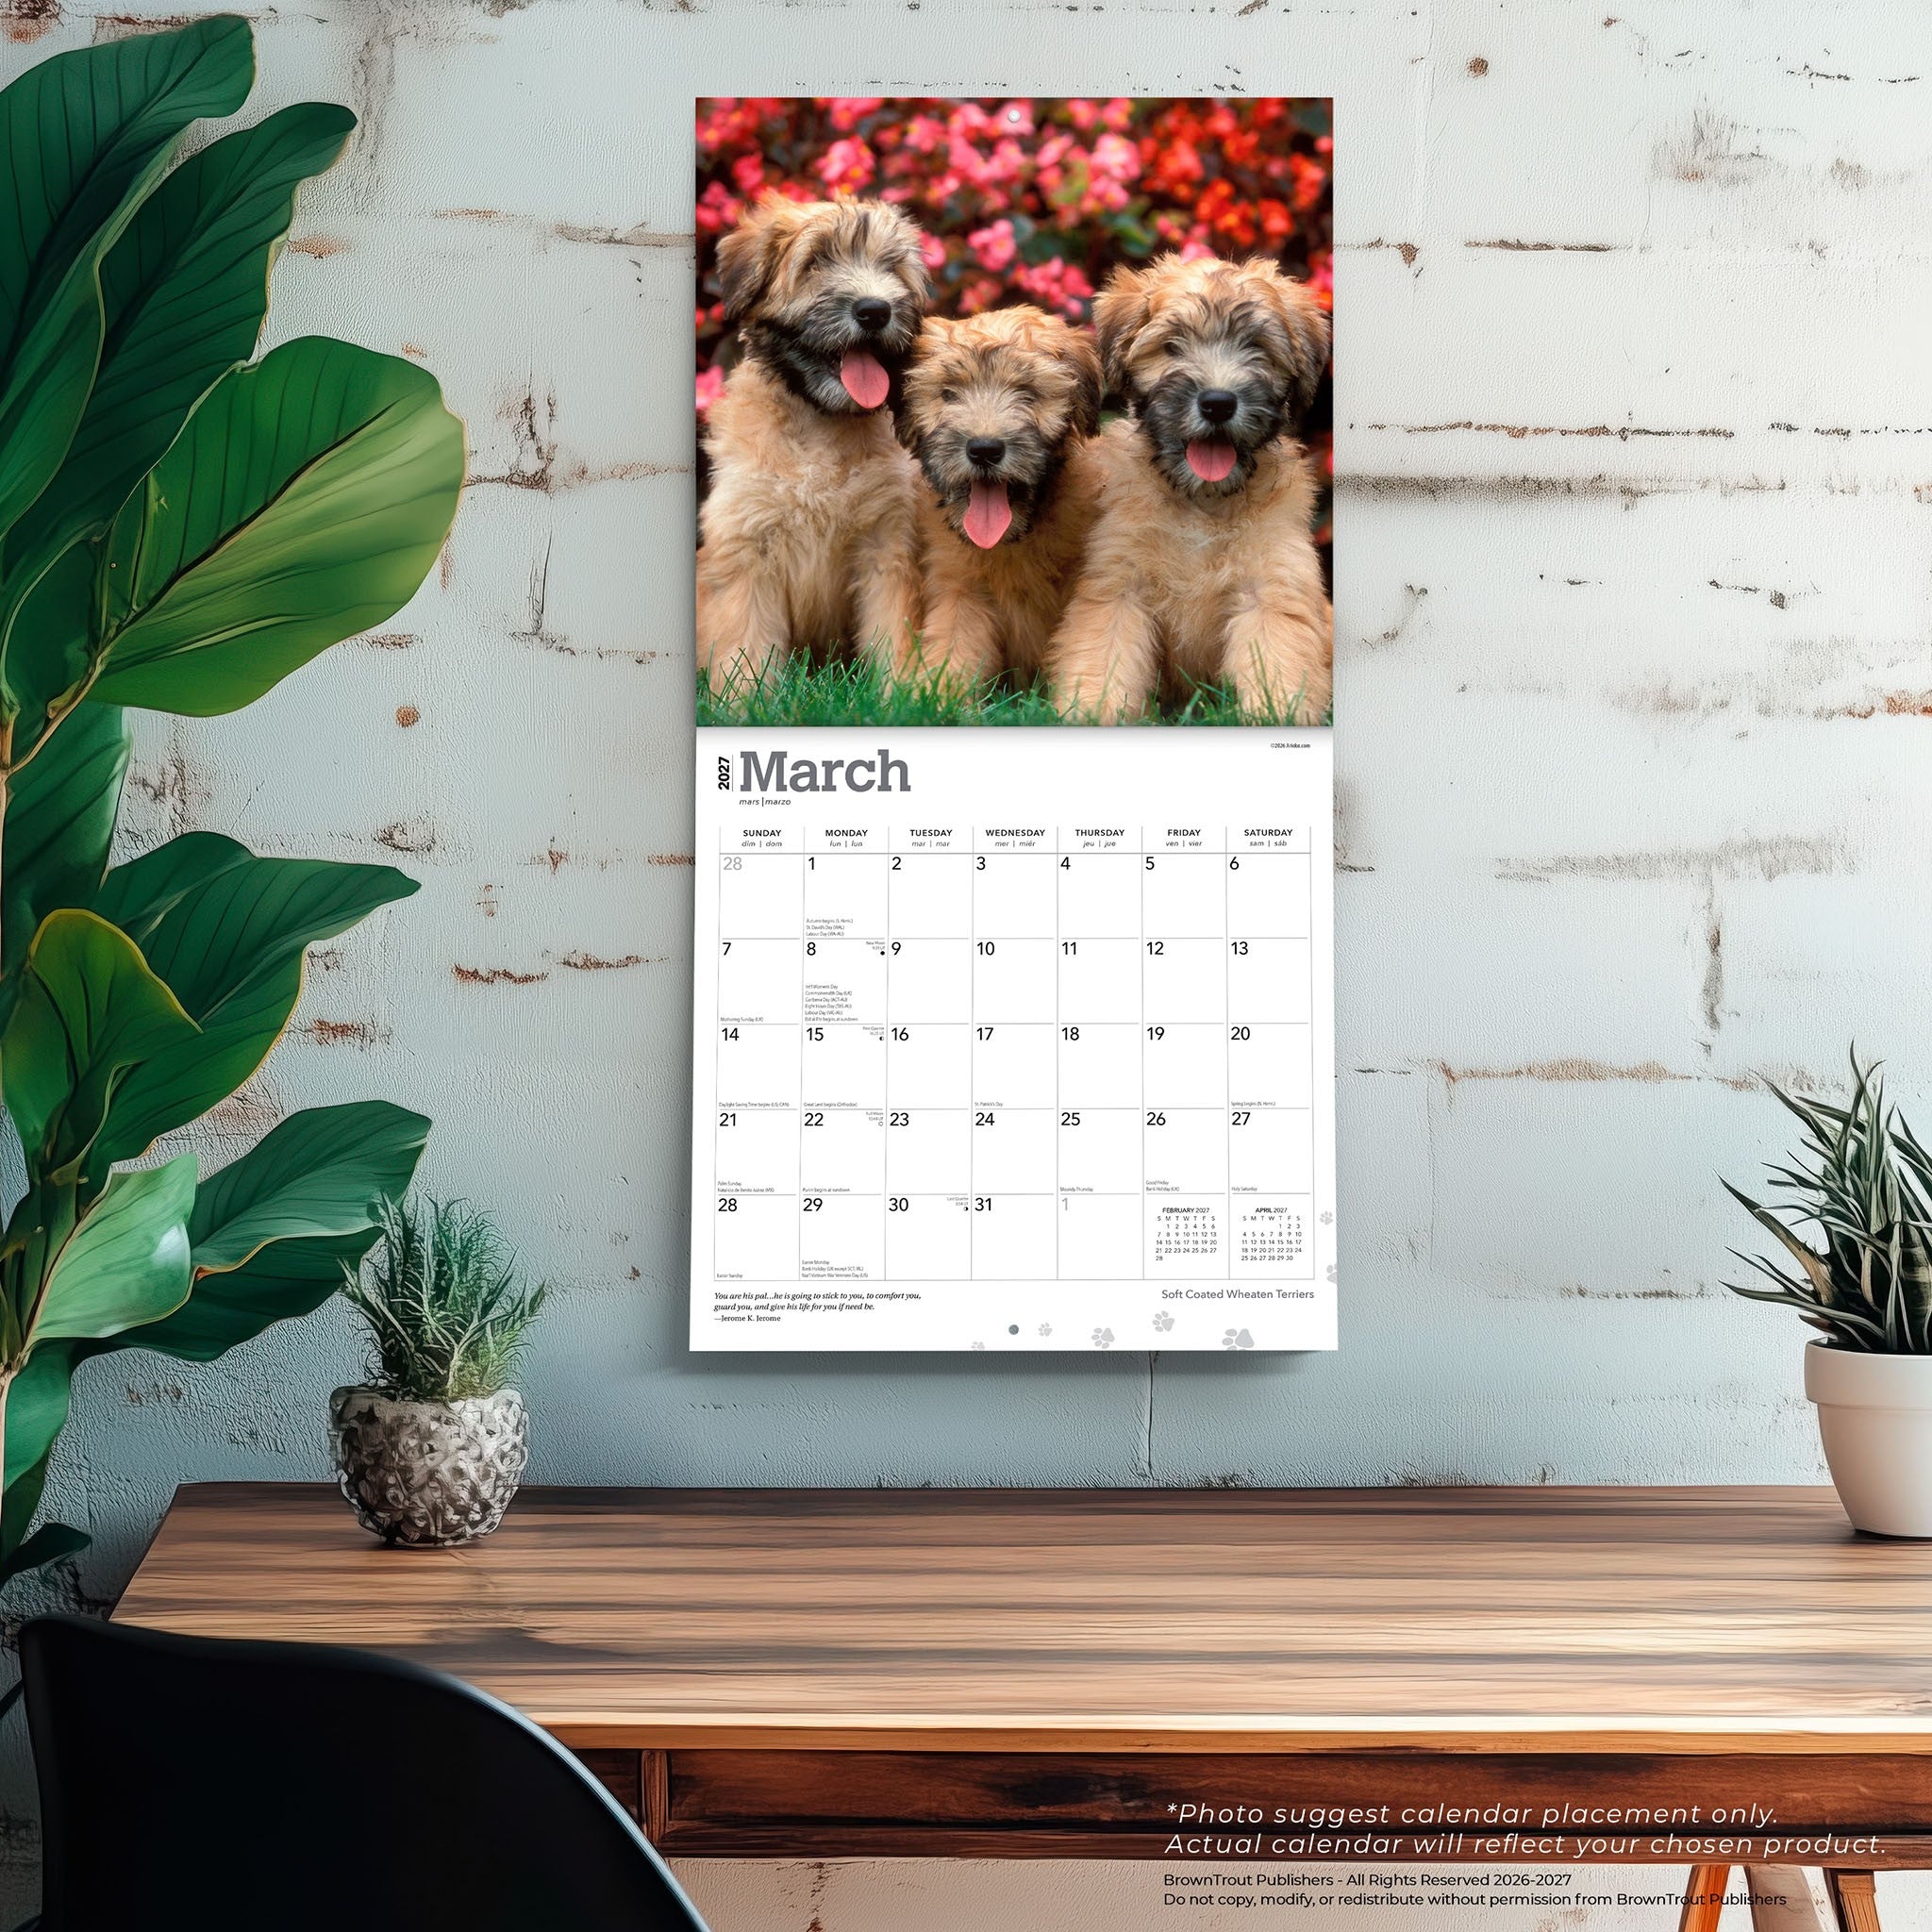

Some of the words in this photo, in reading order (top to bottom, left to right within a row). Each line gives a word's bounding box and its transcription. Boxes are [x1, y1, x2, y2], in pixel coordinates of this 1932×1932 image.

[718, 756, 730, 791] 2027
[741, 749, 911, 792] March
[743, 829, 781, 838] SUNDAY
[825, 828, 868, 838] MONDAY
[909, 828, 952, 838] TUESDAY
[986, 828, 1045, 838] WEDNESDAY
[1075, 828, 1124, 837] THURSDAY
[1168, 828, 1201, 837] FRIDAY
[1244, 828, 1292, 837] SATURDAY
[1083, 840, 1094, 849] jeu
[1104, 841, 1116, 849] jue
[724, 857, 741, 870] 28
[808, 857, 814, 870] 1
[892, 857, 901, 870] 2
[976, 857, 986, 870] 3
[1060, 857, 1071, 870] 4
[1145, 857, 1155, 870] 5
[1230, 857, 1239, 870] 6
[723, 942, 731, 956] 7
[807, 941, 816, 956] 8
[891, 941, 901, 956] 9
[977, 941, 994, 956] 10
[1062, 941, 1076, 955] 11
[1147, 941, 1163, 955] 12
[1231, 941, 1248, 955] 13
[722, 1027, 740, 1041] 14
[807, 1027, 824, 1041] 15
[891, 1027, 908, 1041] 16
[976, 1027, 993, 1041] 17
[1061, 1027, 1079, 1041] 18
[1147, 1026, 1164, 1041] 19
[1231, 1026, 1250, 1041] 20
[720, 1113, 736, 1126] 21
[805, 1112, 824, 1126] 22
[890, 1112, 908, 1126] 23
[975, 1112, 995, 1125] 24
[1061, 1112, 1080, 1125] 25
[1147, 1112, 1166, 1125] 26
[1232, 1112, 1251, 1125] 27
[718, 1198, 737, 1212] 28
[803, 1198, 823, 1211] 29
[889, 1198, 908, 1211] 30
[974, 1197, 991, 1211] 31
[1061, 1197, 1069, 1211] 1
[755, 1292, 782, 1301] pal...he
[791, 1292, 811, 1301] going
[875, 1292, 904, 1301] comfort
[1162, 1290, 1183, 1298] Soft
[1186, 1290, 1224, 1298] Coated
[1226, 1290, 1273, 1298] Wheaten
[1276, 1290, 1314, 1298] Terriers
[799, 1303, 810, 1311] life
[810, 1303, 823, 1311] for
[838, 1303, 845, 1311] if
